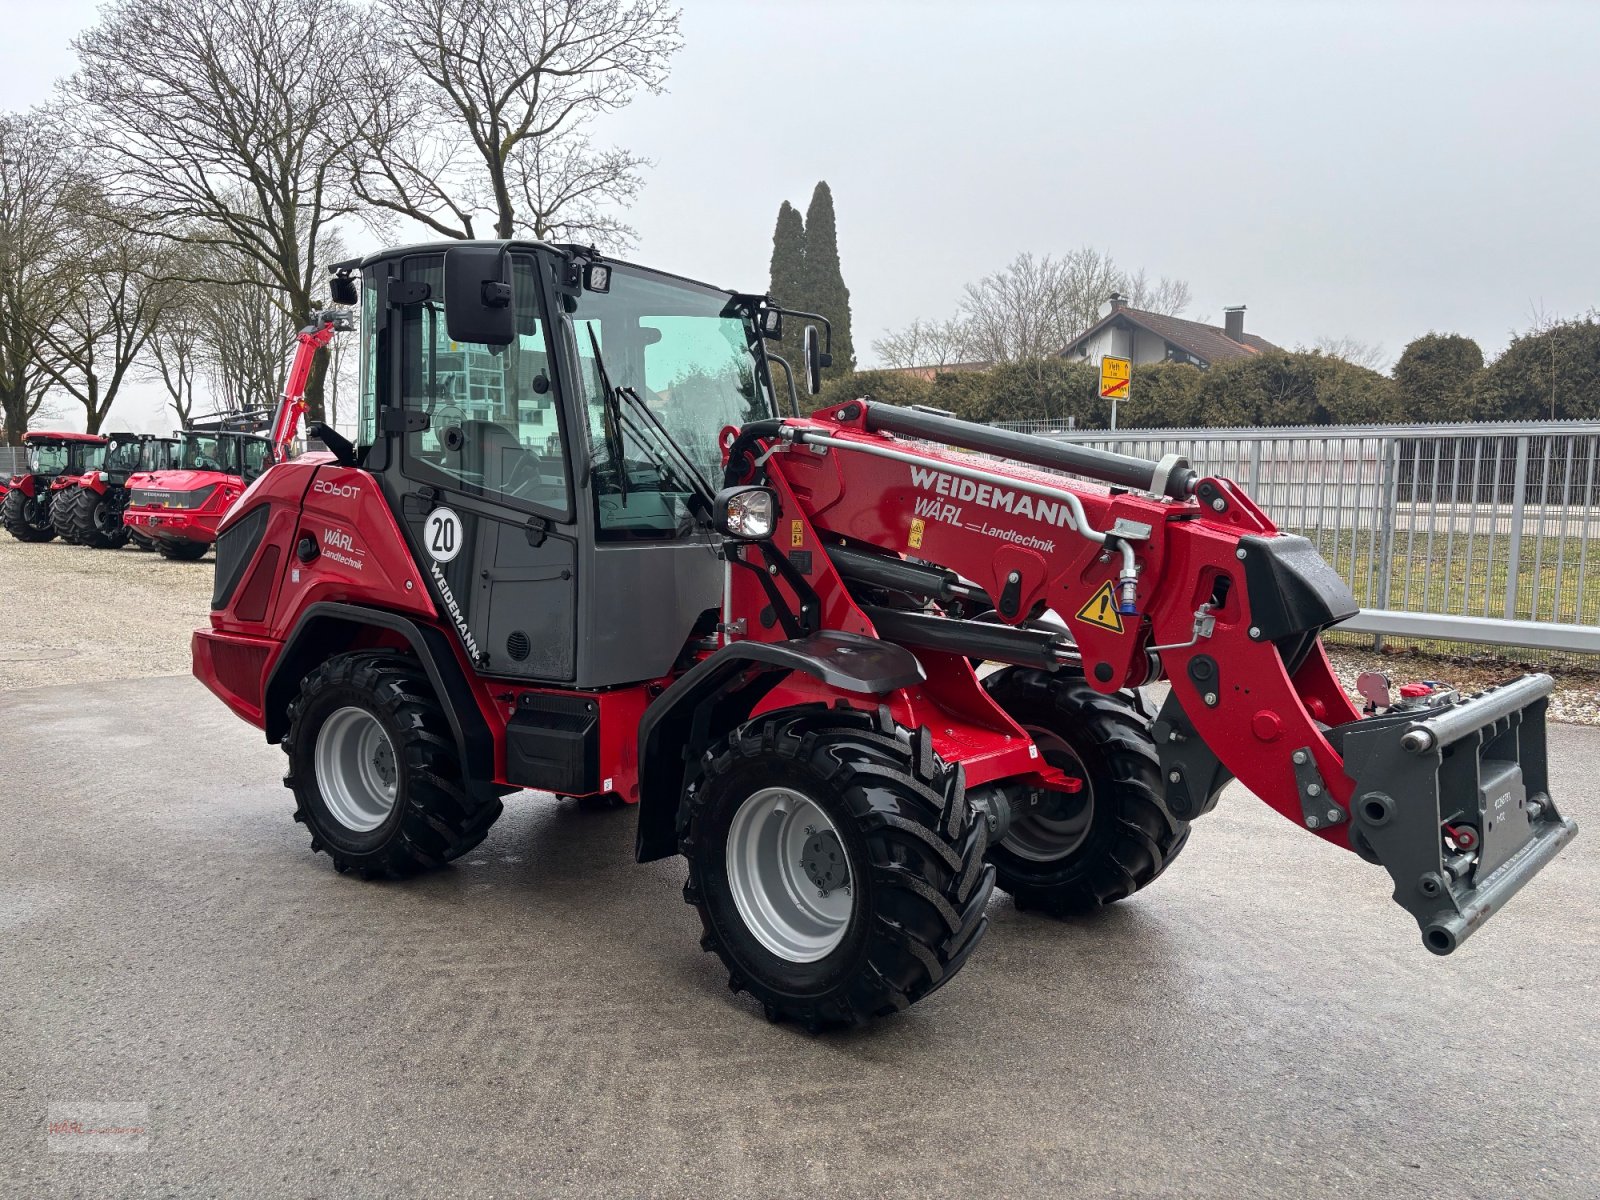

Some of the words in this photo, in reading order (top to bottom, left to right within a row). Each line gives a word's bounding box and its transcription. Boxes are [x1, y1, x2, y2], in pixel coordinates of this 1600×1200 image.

[313, 480, 361, 499] 2060T
[909, 465, 1079, 532] WEIDEMANN
[324, 528, 354, 552] WÄRL
[432, 517, 455, 552] 20
[914, 496, 963, 527] WÄRL
[980, 522, 1056, 553] Landtechnik
[321, 546, 364, 571] Landtechnik
[430, 560, 480, 660] WEIDEMANN
